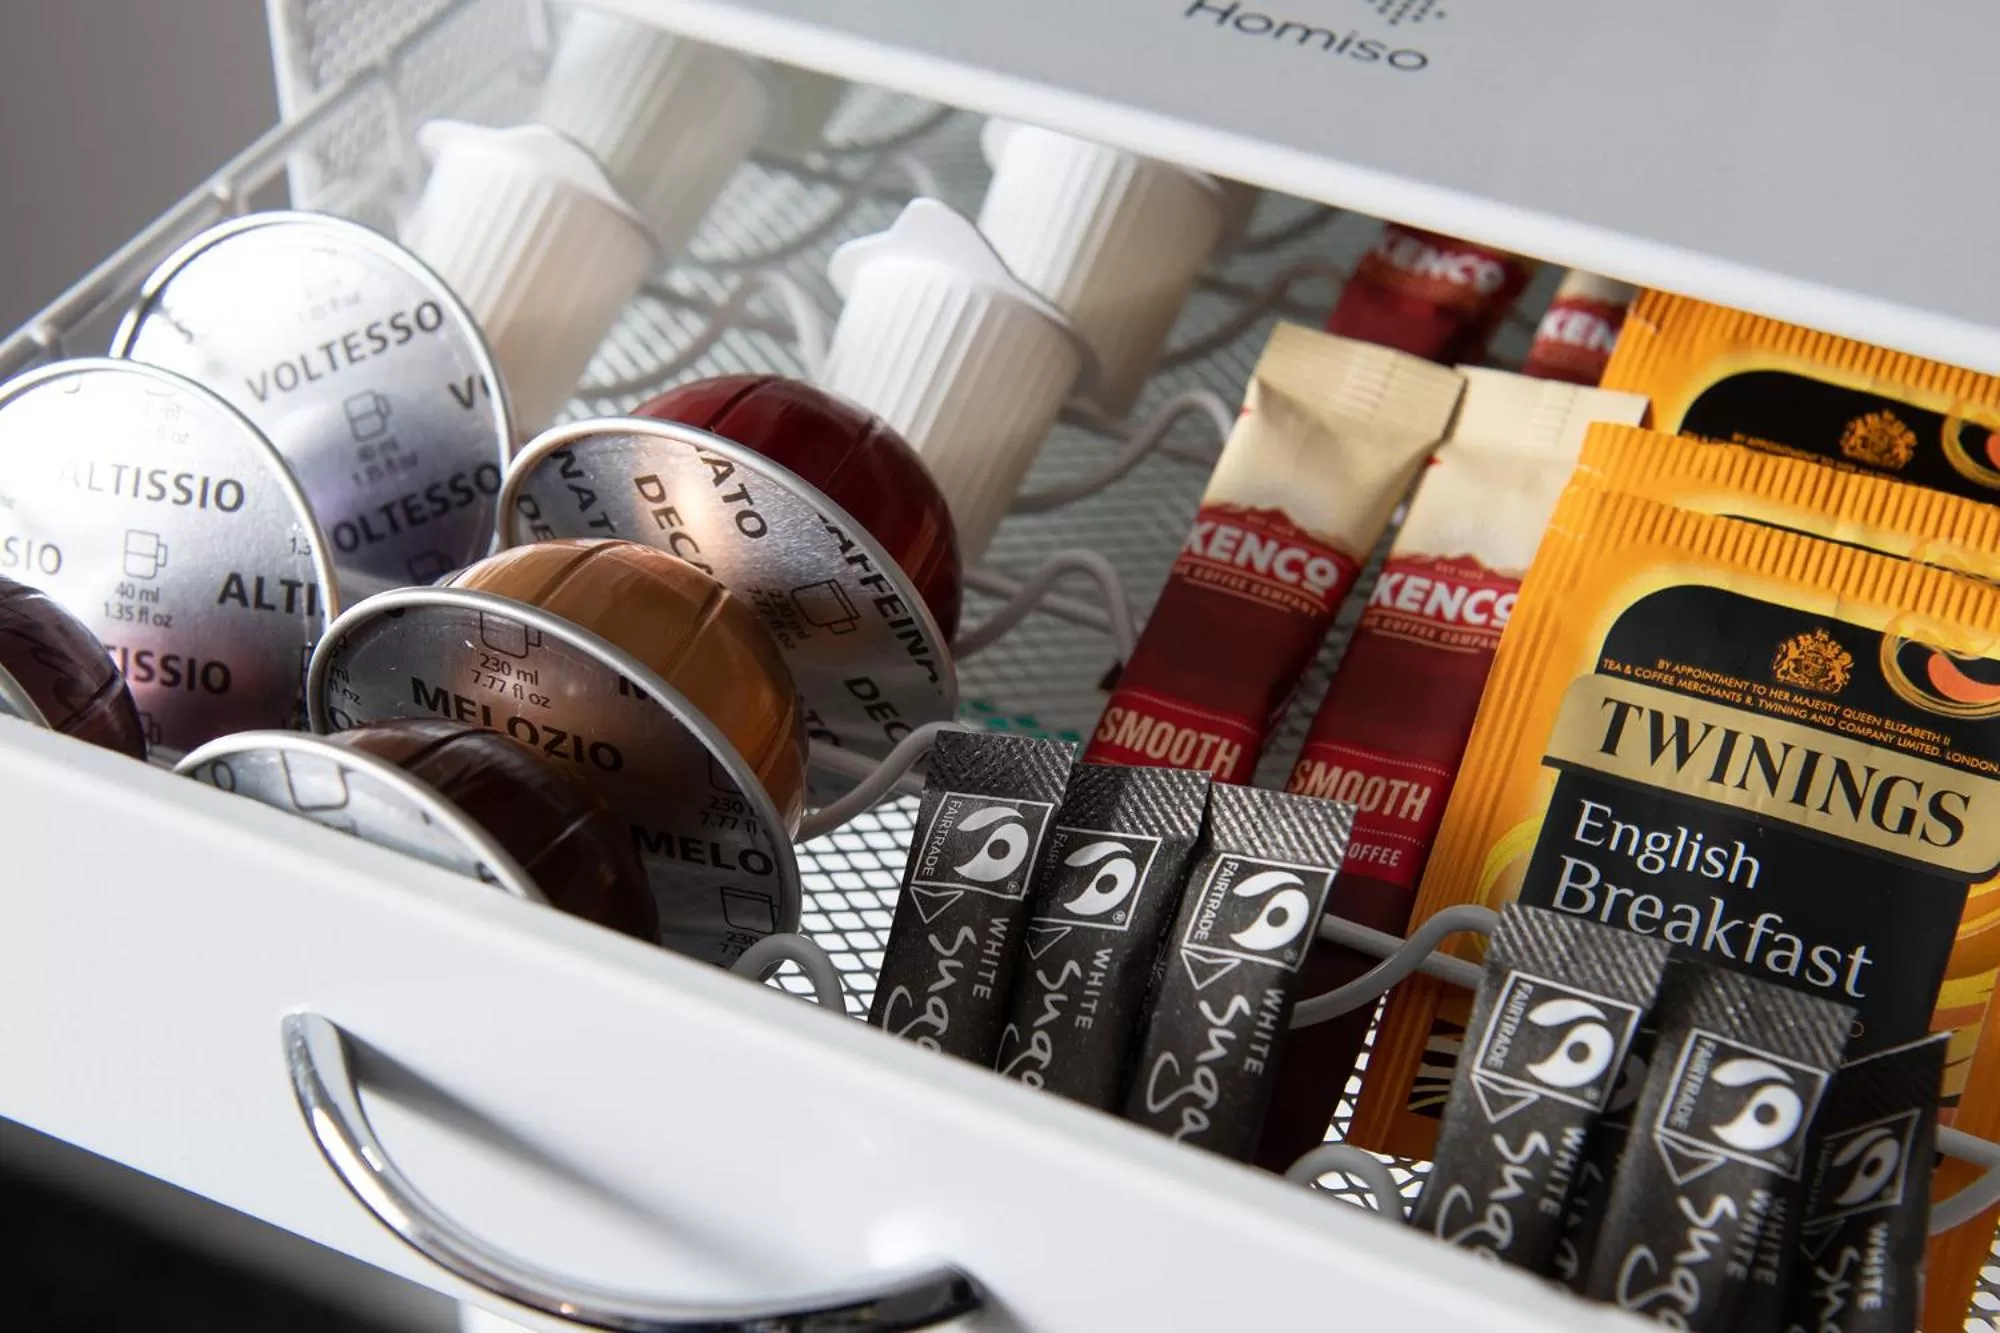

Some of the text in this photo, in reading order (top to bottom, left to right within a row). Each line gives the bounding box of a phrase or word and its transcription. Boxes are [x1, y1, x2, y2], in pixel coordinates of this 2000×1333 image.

[1184, 0, 1429, 71] Homiso
[244, 300, 444, 402] VOLTESSO
[139, 586, 161, 604] ml
[217, 571, 325, 618] ALTI
[1183, 519, 1339, 597] KENCO
[152, 613, 173, 629] oz
[471, 668, 552, 709] 7.77 fl oz
[479, 652, 539, 686] 230 ml
[1603, 657, 1622, 673] TEA
[1624, 664, 1632, 675] &
[1634, 666, 1675, 686] COFFEE
[1676, 677, 1742, 704] MERCHANTS
[1758, 698, 1808, 720] TWINING
[1809, 713, 1836, 727] AND
[1837, 719, 1898, 745] COMPANY
[1657, 658, 1951, 747] BY APPOINTMENT TO HER MAJESTY QUEEN ELIZABETH II
[1096, 707, 1242, 779] SMOOTH
[1597, 697, 1972, 848] TWININGS
[1288, 758, 1433, 823] SMOOTH
[629, 823, 774, 876] MELO
[921, 799, 963, 878] FAIRTRADE
[1573, 798, 1761, 889] English
[1194, 859, 1240, 941] FAIRTRADE
[1551, 853, 1875, 999] Breakfast
[972, 917, 1011, 1001] WHITE
[1074, 947, 1114, 1030] WHITE
[1243, 988, 1286, 1076] WHITE
[1485, 981, 1535, 1069] FAIRTRADE
[1668, 1037, 1718, 1131] FAIRTRADE
[1538, 1125, 1588, 1216] WHITE
[1725, 1188, 1774, 1282] WHITE
[1856, 1220, 1891, 1312] WHITE
